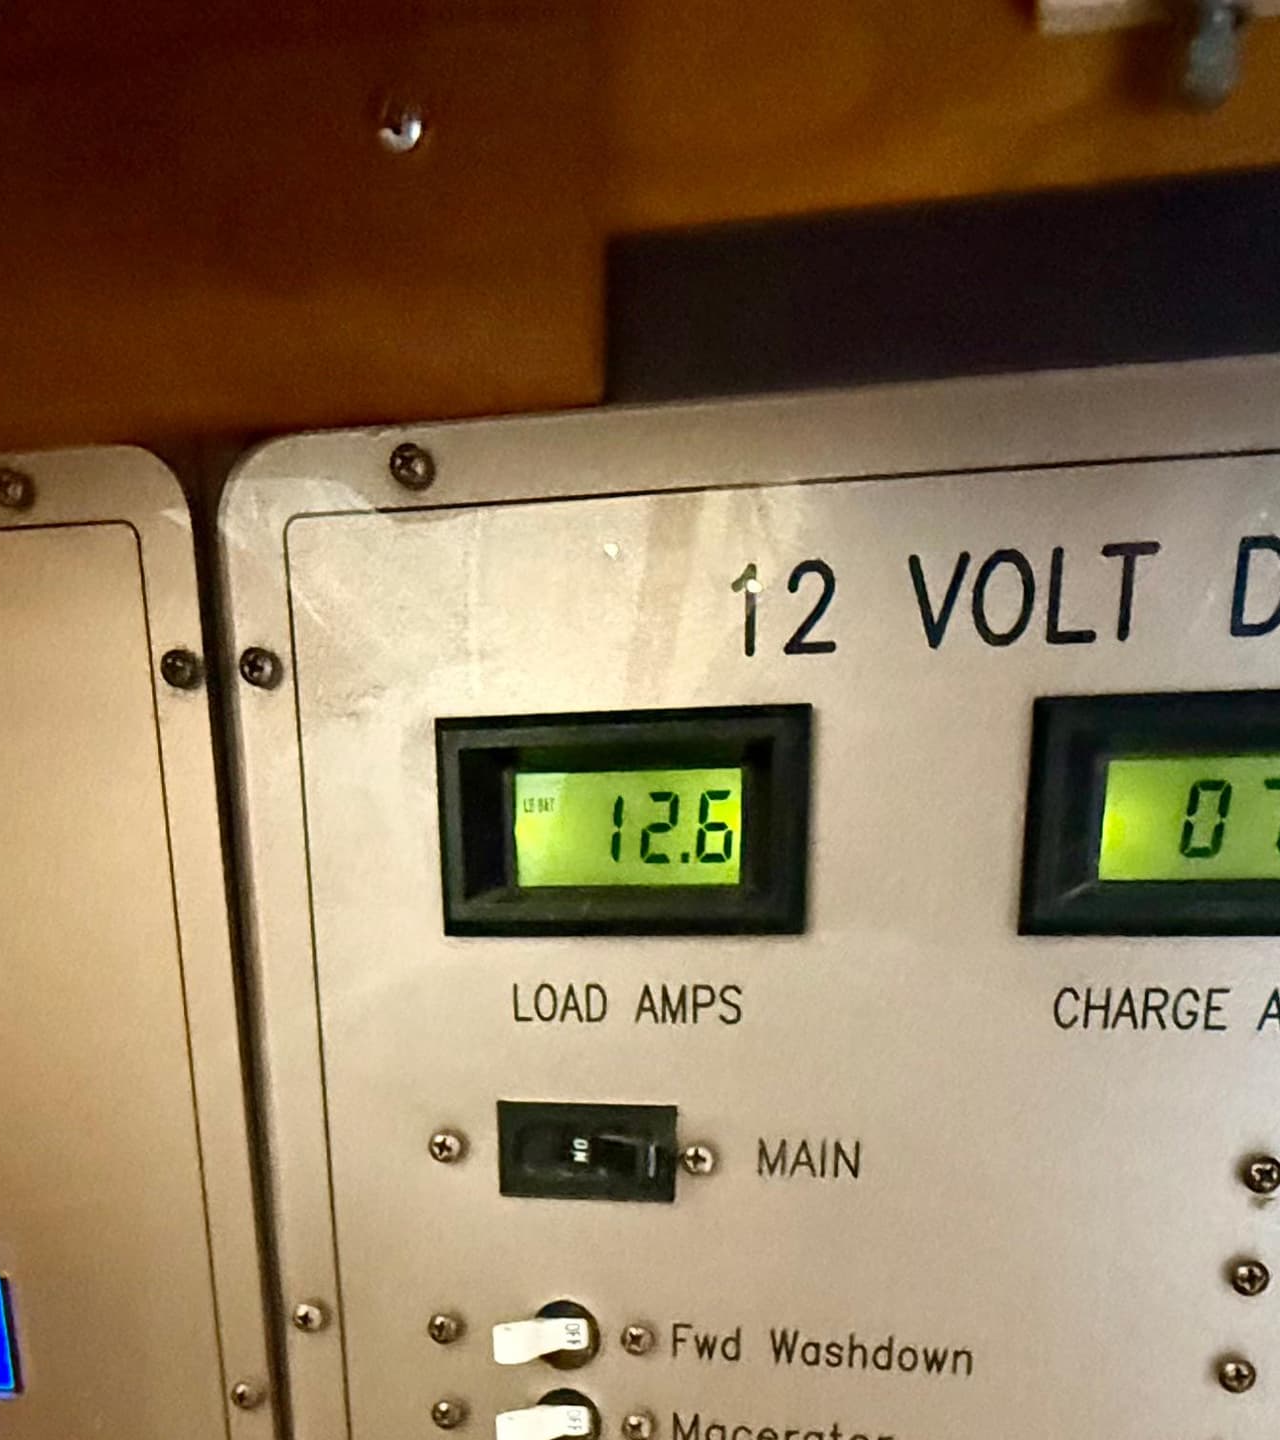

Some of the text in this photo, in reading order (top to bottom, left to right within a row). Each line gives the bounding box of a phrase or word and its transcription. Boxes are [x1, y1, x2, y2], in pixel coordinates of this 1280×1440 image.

[731, 558, 836, 657] 12
[908, 541, 1160, 650] VOLT
[611, 790, 733, 864] 12.6
[513, 983, 742, 1025] LOAD AMPS
[1054, 987, 1230, 1031] CHARGE
[757, 1138, 860, 1179] MAIN
[672, 1323, 972, 1376] Fwd Washdown
